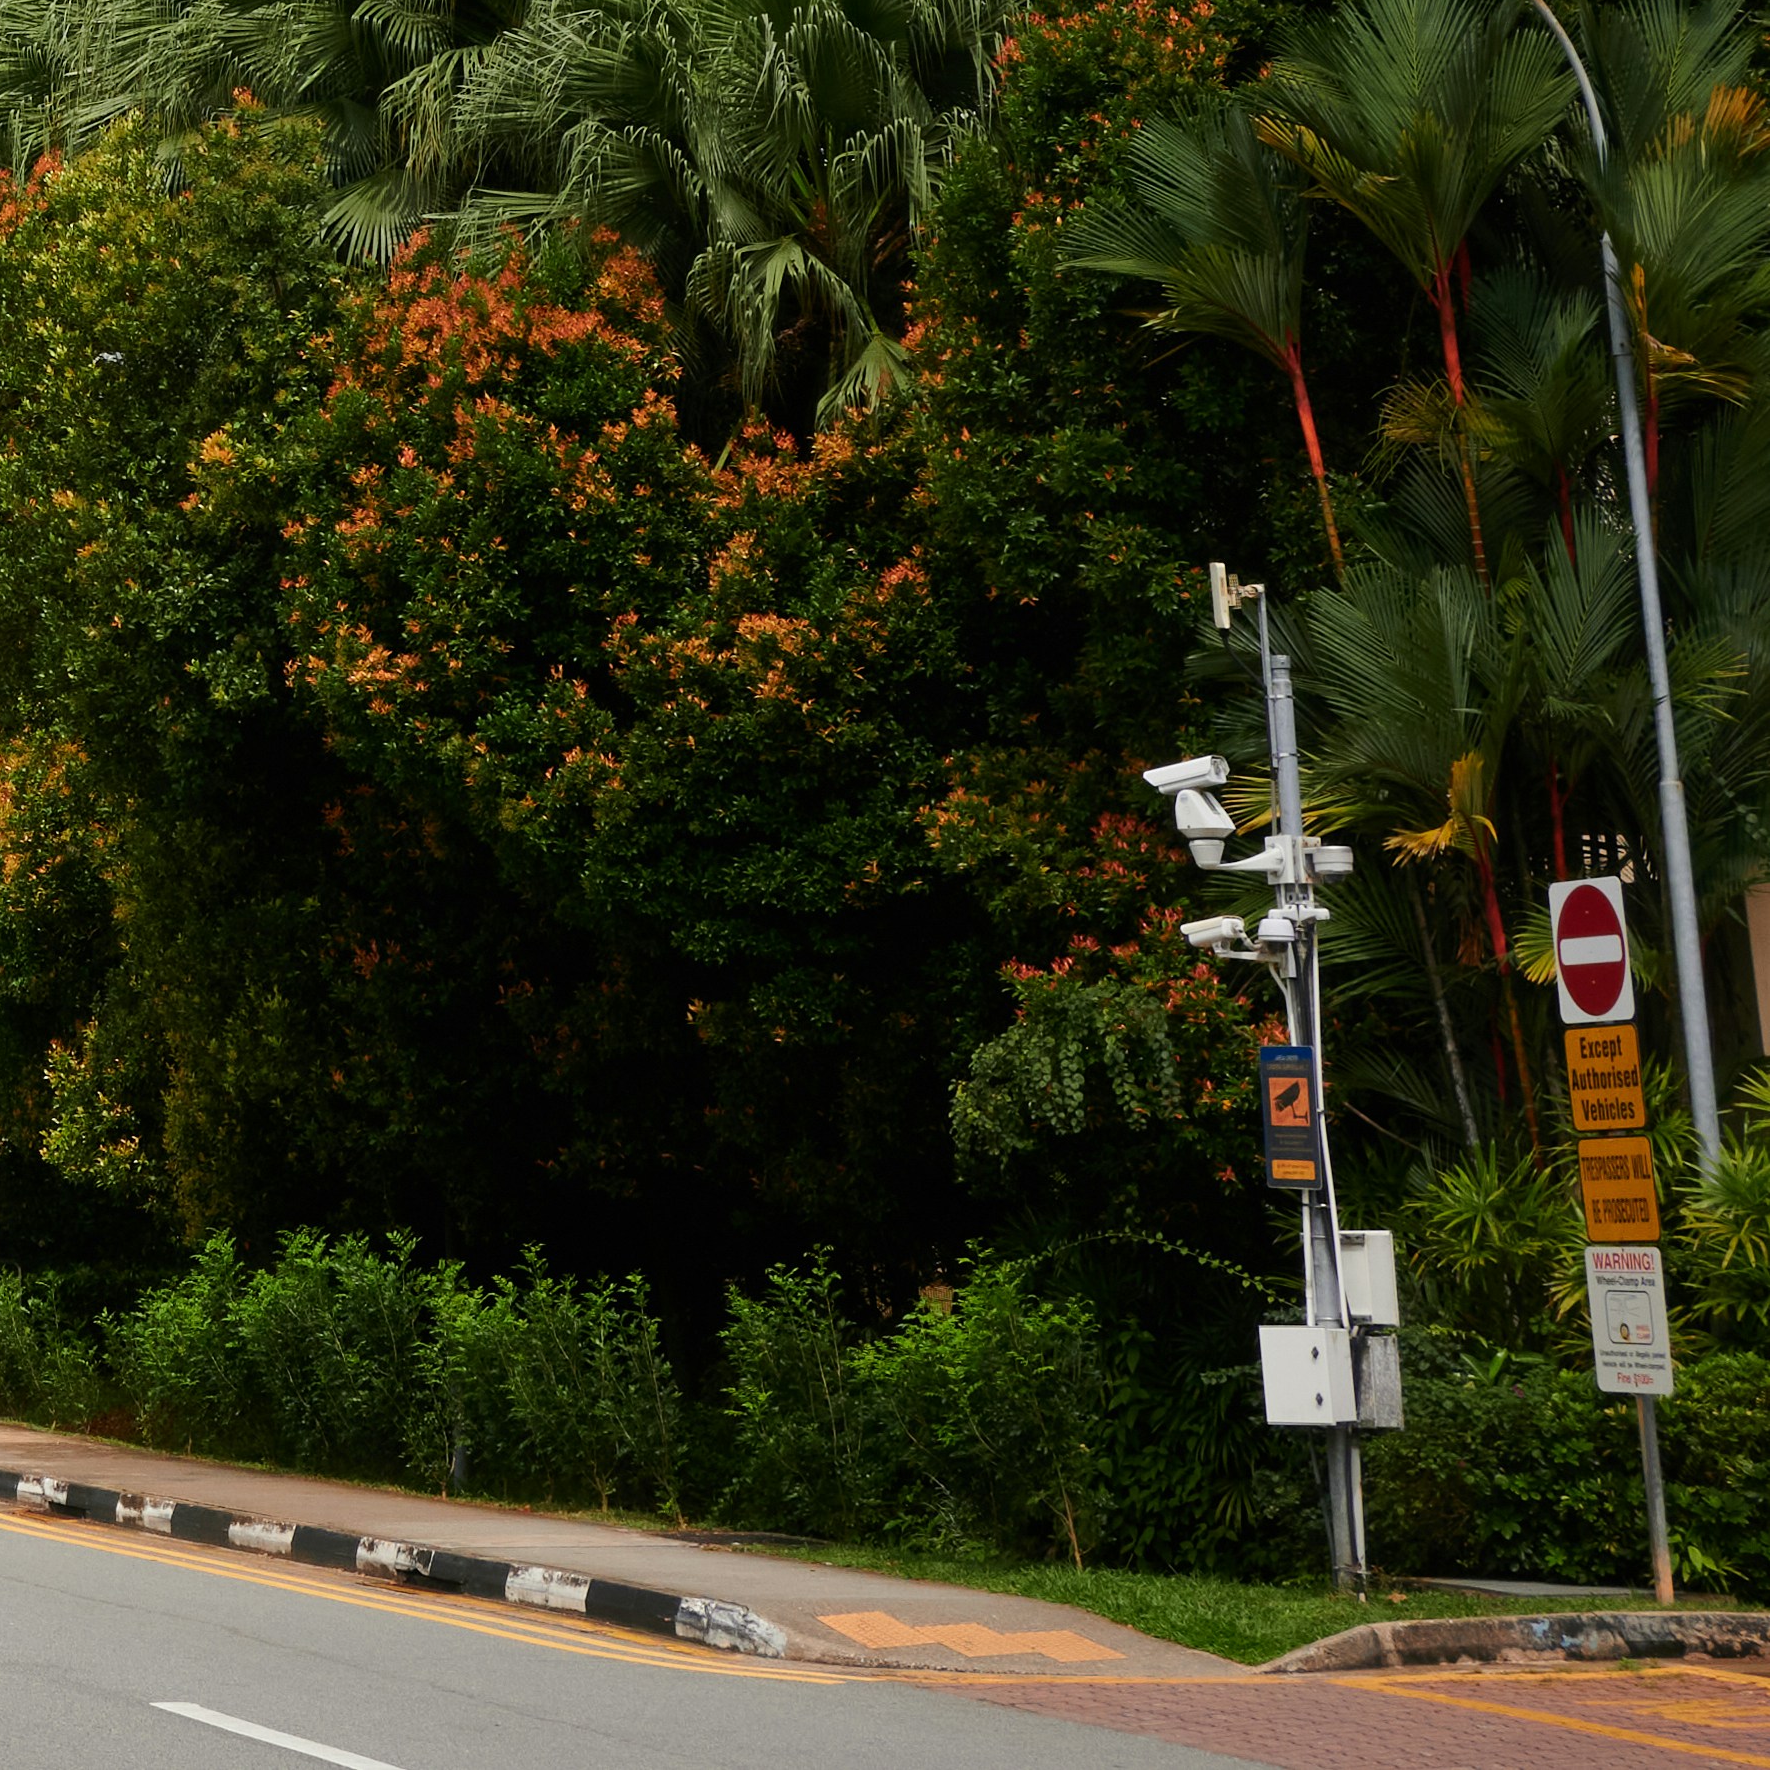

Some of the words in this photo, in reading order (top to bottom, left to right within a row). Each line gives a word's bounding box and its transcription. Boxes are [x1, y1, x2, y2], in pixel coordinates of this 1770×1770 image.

[1579, 1034, 1623, 1062] Except
[1572, 1064, 1639, 1091] Authorised
[1581, 1096, 1636, 1122] Vehicles
[1581, 1154, 1630, 1181] TRESPASSERS
[1631, 1154, 1651, 1180] WILL
[1592, 1199, 1602, 1224] BE
[1603, 1197, 1650, 1224] PROSECUTED
[1592, 1252, 1655, 1271] WARNING!
[1641, 1276, 1655, 1287] Area
